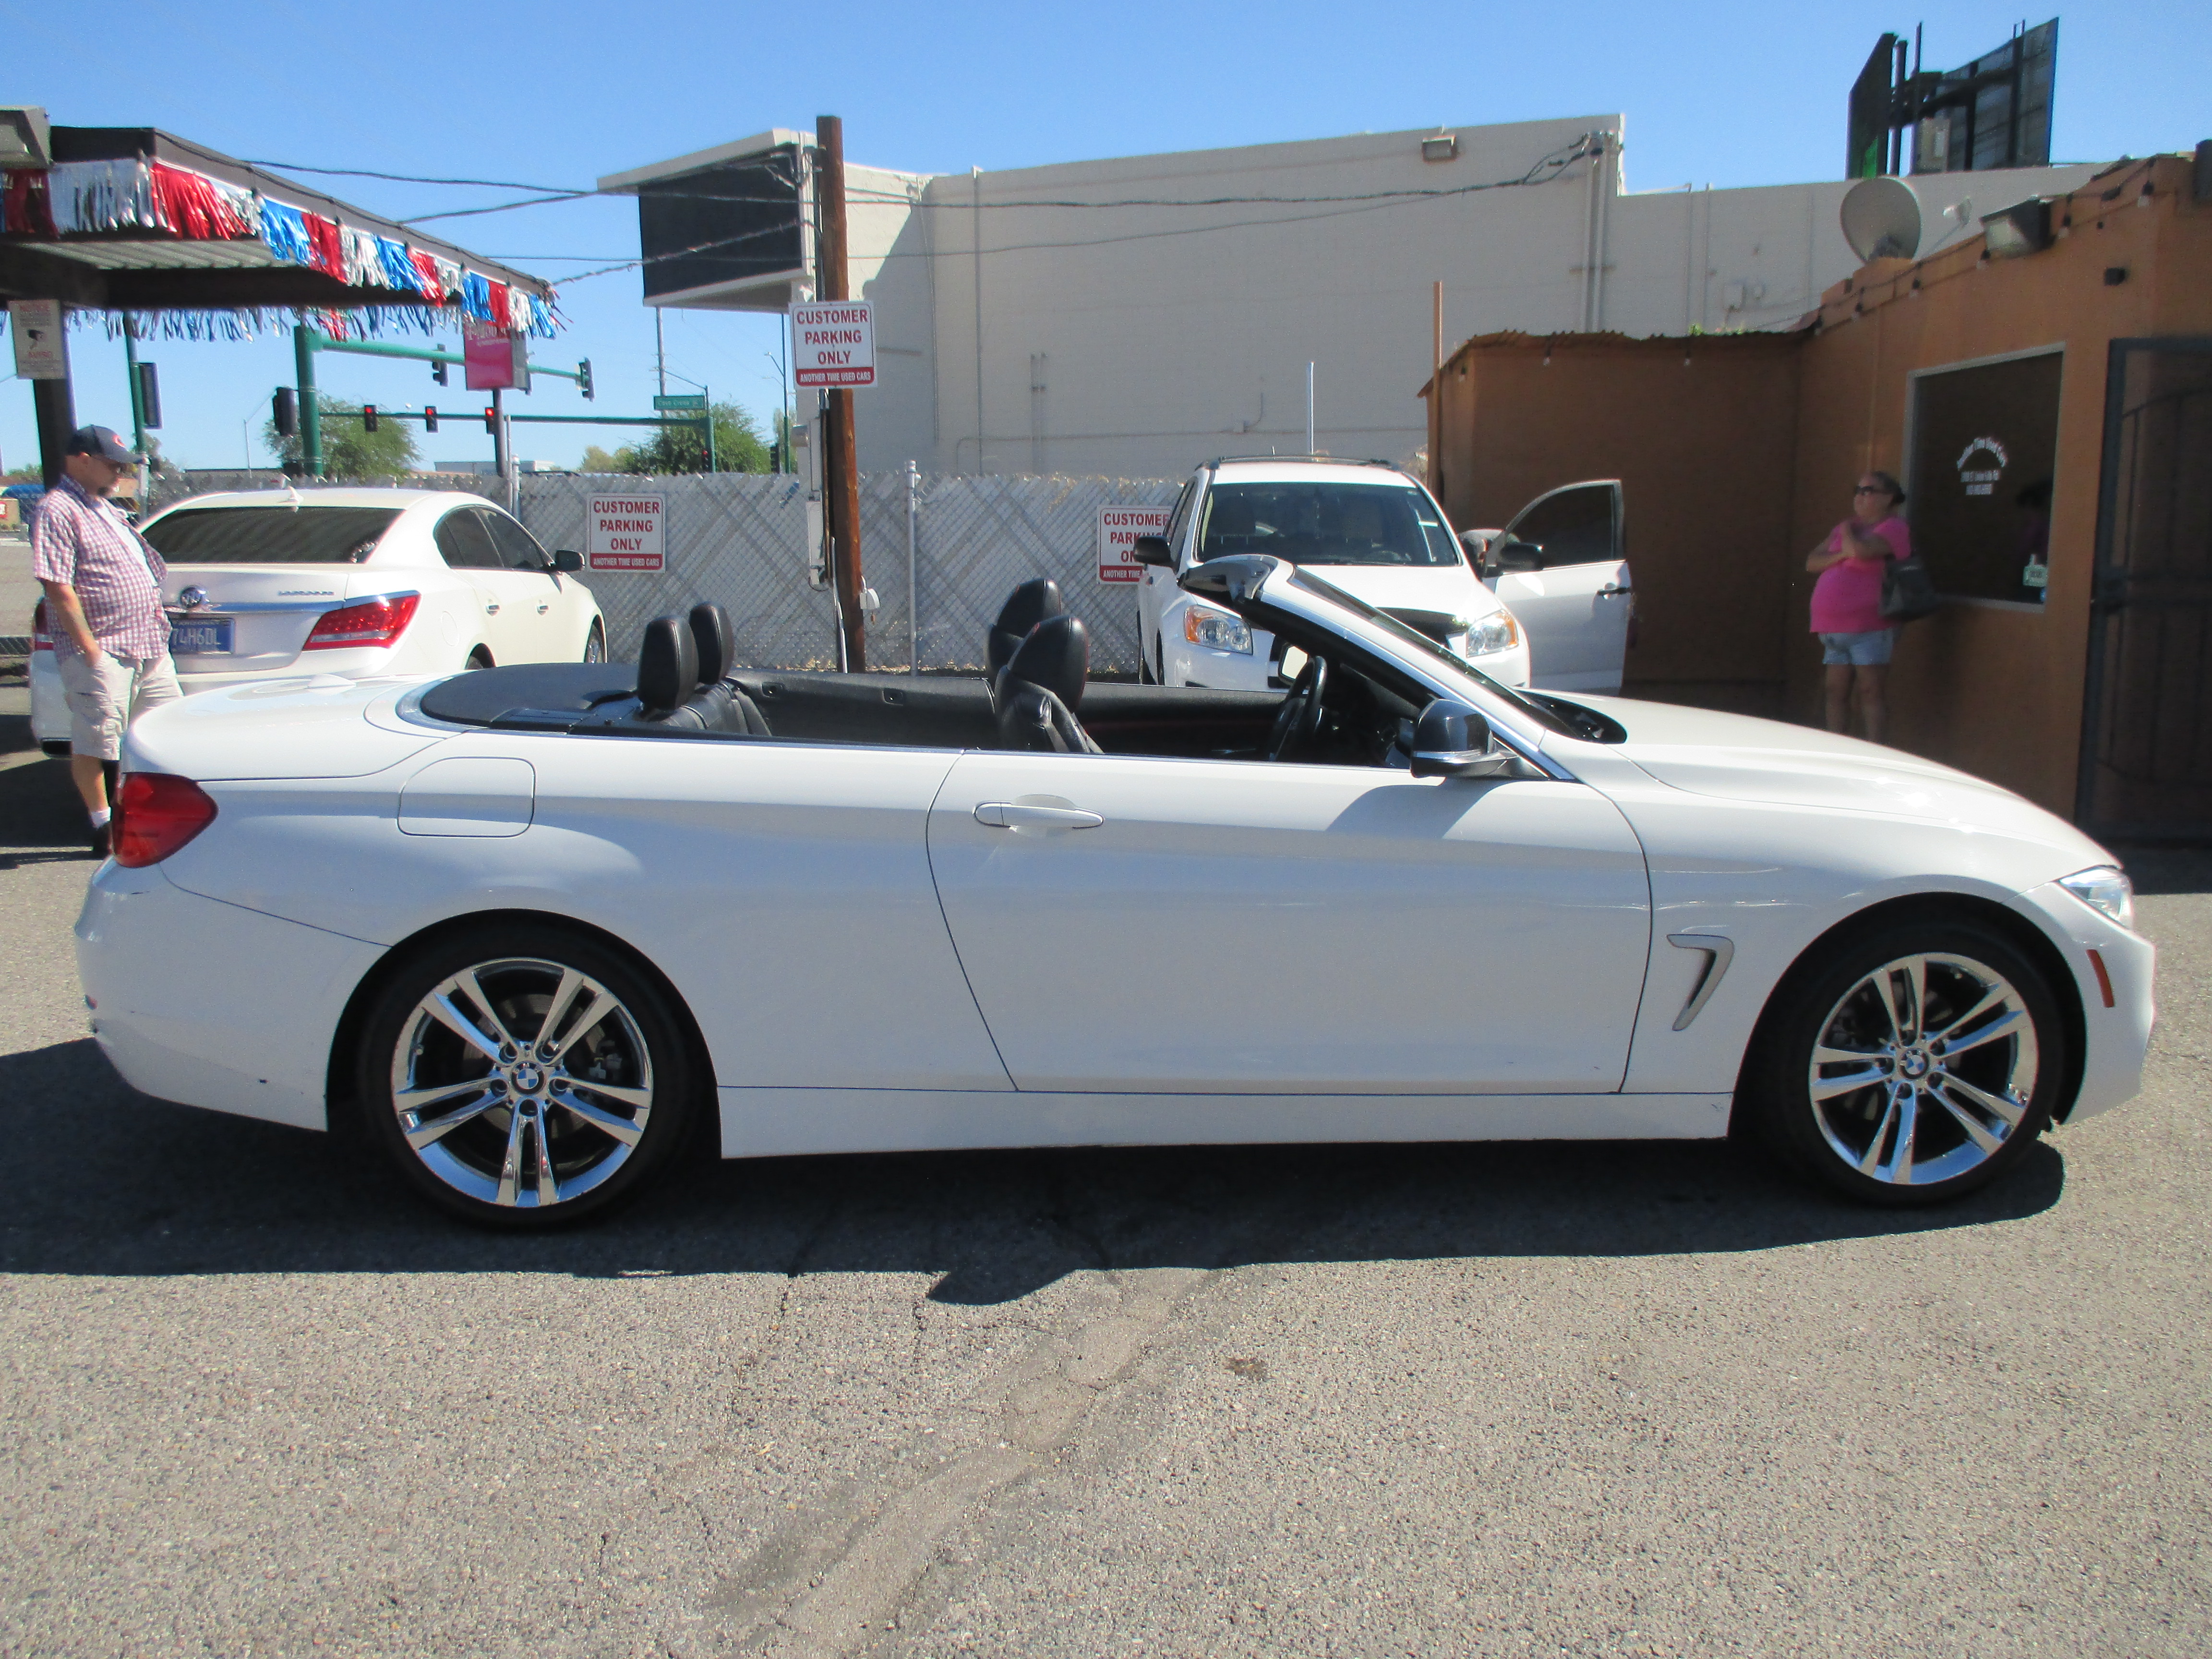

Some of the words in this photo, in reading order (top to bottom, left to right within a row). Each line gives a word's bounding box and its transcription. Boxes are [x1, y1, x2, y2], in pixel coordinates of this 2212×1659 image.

[797, 310, 868, 325] CUSTOMER
[805, 330, 862, 345] PARKING
[818, 350, 851, 365] ONLY
[800, 373, 826, 383] ANOTHER
[828, 373, 840, 382] TIME
[841, 372, 855, 382] USED
[857, 372, 871, 381] CARS
[594, 501, 660, 514] CUSTOMER
[600, 519, 653, 532] PARKING
[611, 538, 642, 551] ONLY
[1110, 532, 1162, 544] PARK
[594, 557, 617, 566] ANOTHER
[618, 558, 630, 566] TIME
[632, 558, 645, 566] USED
[646, 558, 660, 566] CARS
[1103, 570, 1127, 578] ANOTHER
[1129, 570, 1141, 578] TIME
